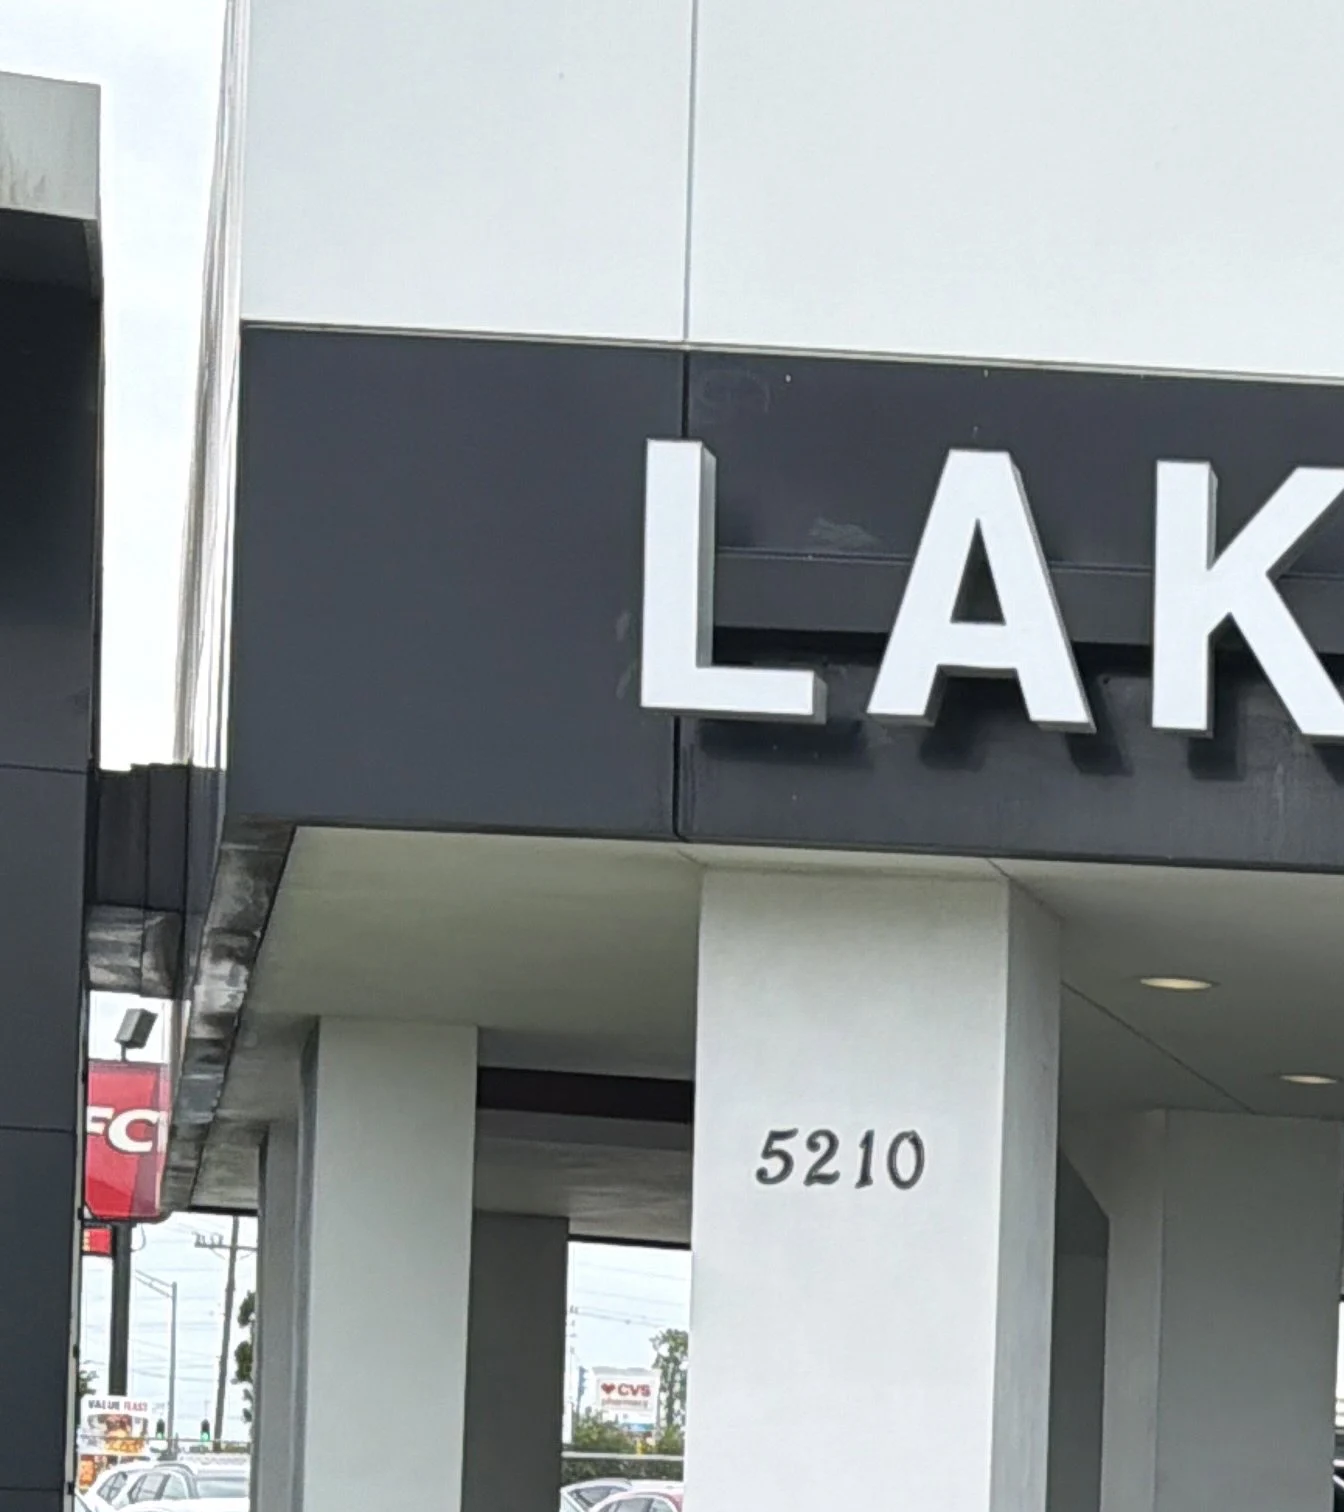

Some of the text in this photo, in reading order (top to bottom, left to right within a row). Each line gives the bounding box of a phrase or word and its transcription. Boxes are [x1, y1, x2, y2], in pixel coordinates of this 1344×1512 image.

[87, 1106, 160, 1153] FC
[756, 1127, 925, 1190] 5210
[618, 1383, 651, 1397] CVS
